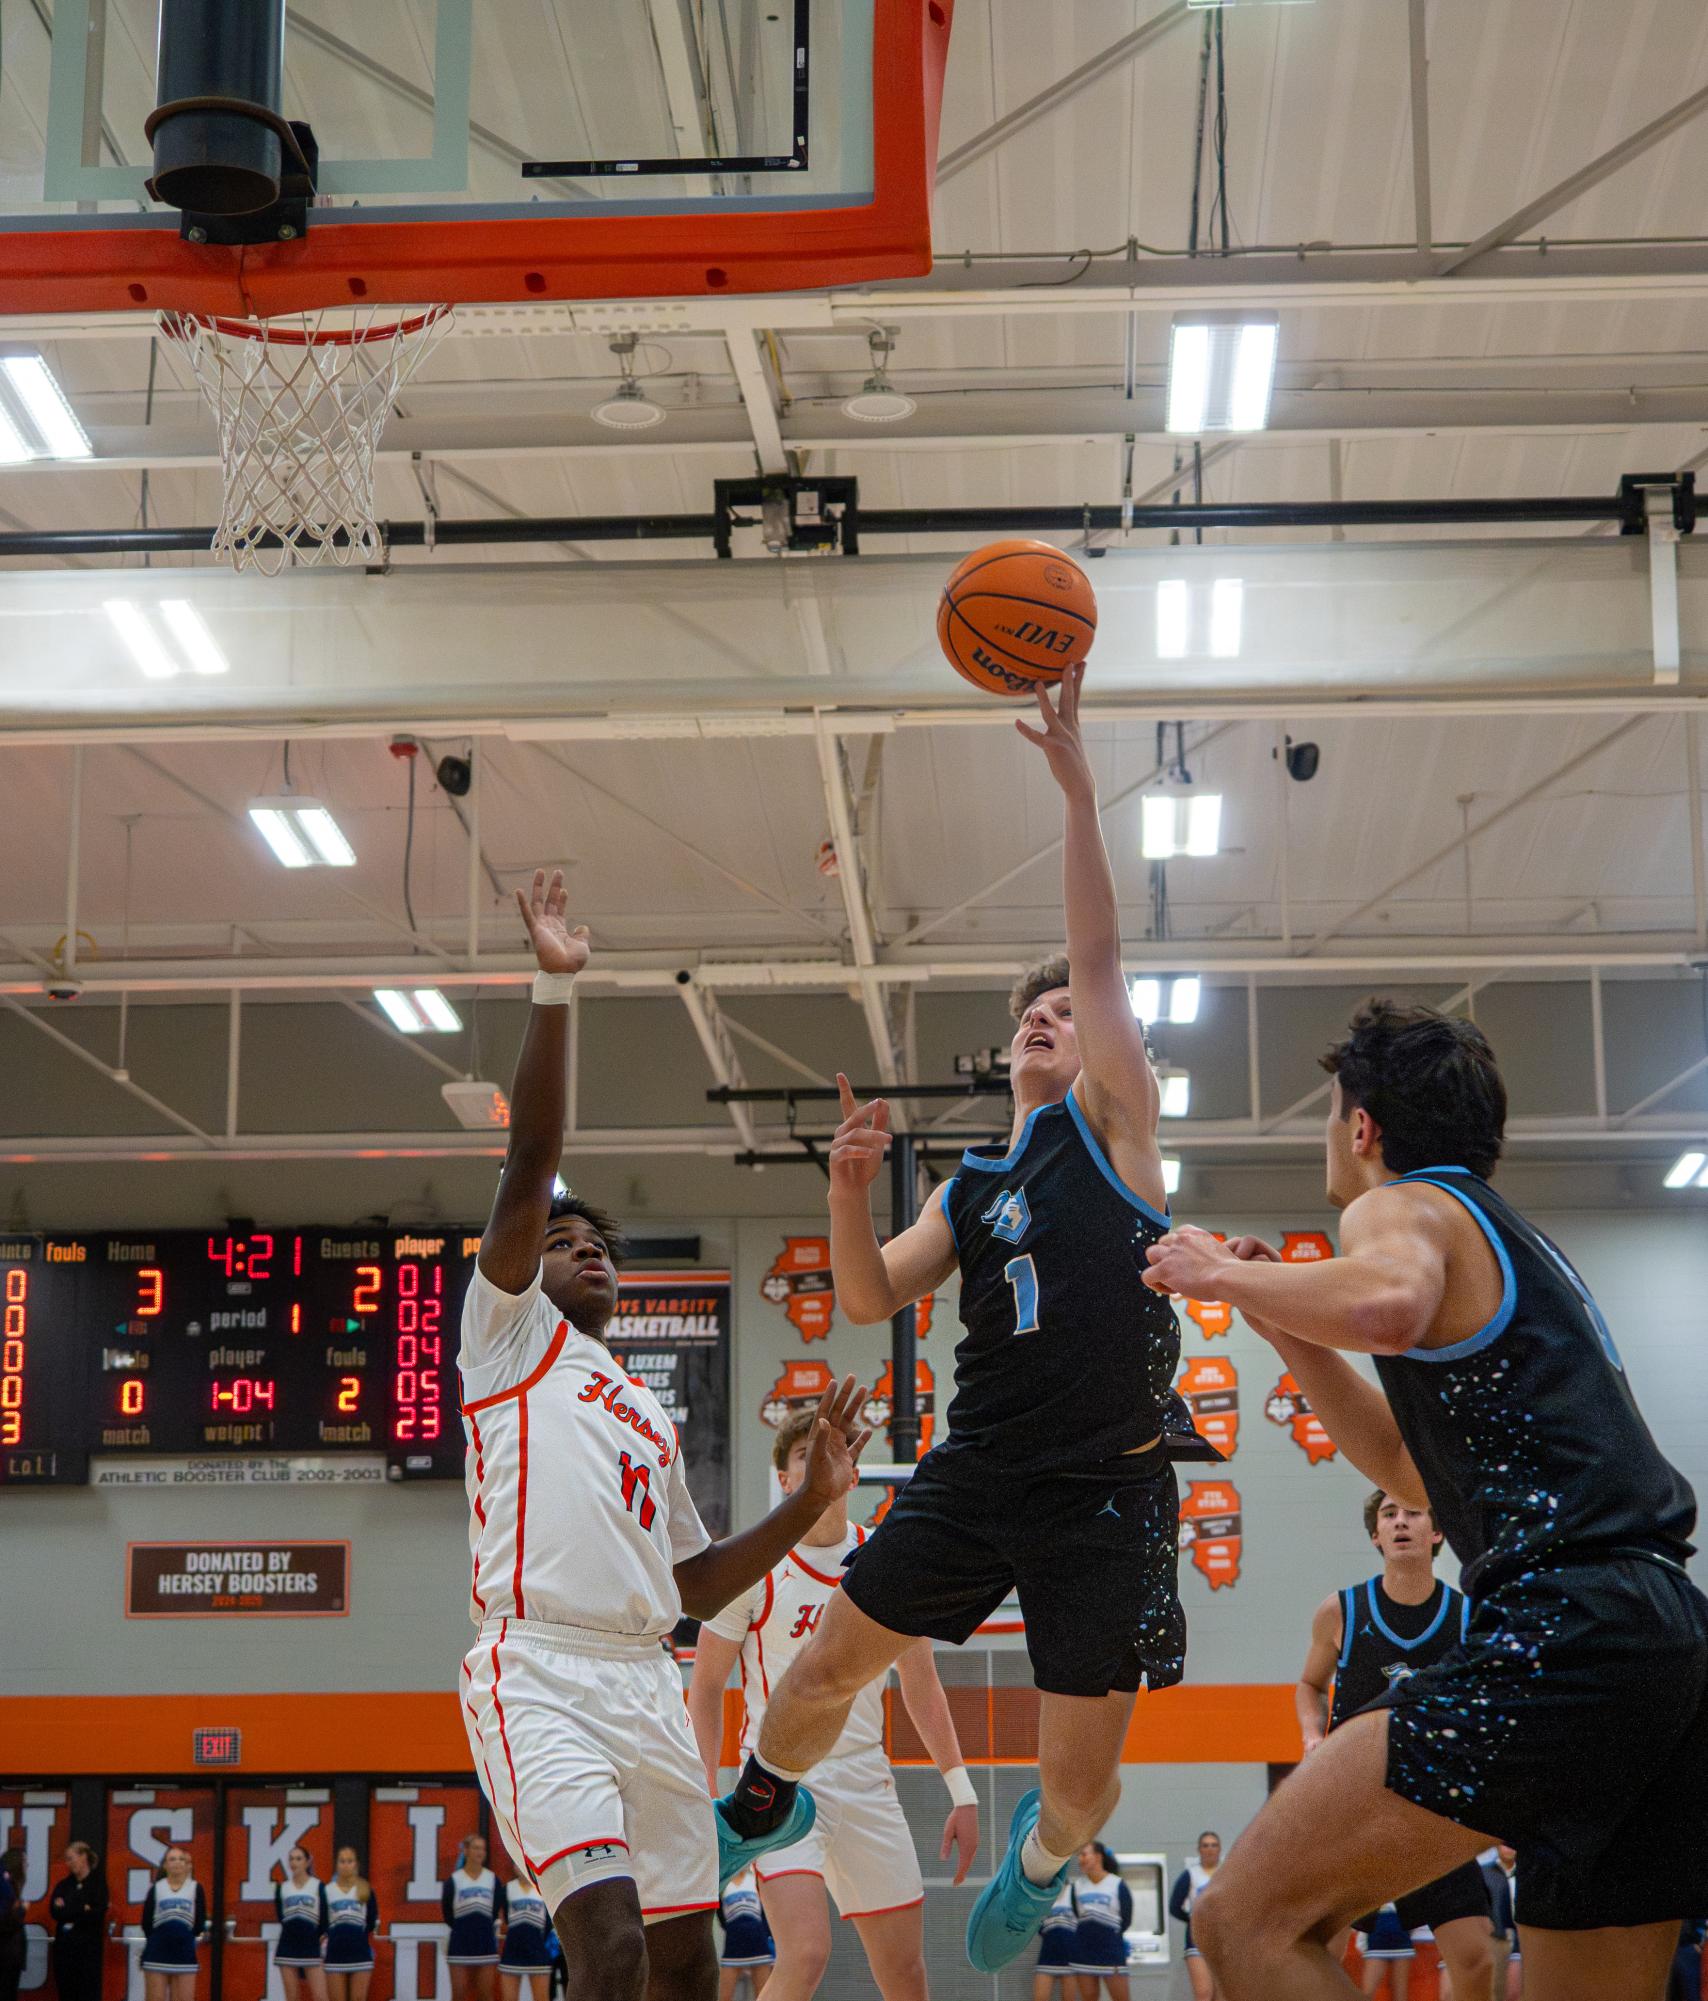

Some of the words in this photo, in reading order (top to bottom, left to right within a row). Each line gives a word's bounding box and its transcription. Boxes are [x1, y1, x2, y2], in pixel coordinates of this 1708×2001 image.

[1014, 620, 1076, 654] EVO
[46, 1241, 87, 1263] fouls
[107, 1241, 156, 1261] Home
[320, 1237, 381, 1259] Guests
[394, 1235, 446, 1259] player
[6, 1269, 27, 1302] 0
[137, 1269, 162, 1315] 3
[354, 1266, 382, 1312] 2
[1004, 1253, 1040, 1335] 1
[292, 1303, 300, 1334] 1
[398, 1299, 441, 1332] 02
[645, 1299, 718, 1314] VARSITY
[5, 1304, 26, 1337] 0
[209, 1307, 267, 1331] period
[604, 1315, 720, 1339] ASKETBALL
[3, 1340, 24, 1373] 0
[209, 1346, 266, 1370] player
[326, 1347, 367, 1367] fouls
[397, 1335, 441, 1367] 04
[122, 1380, 144, 1414] 0
[338, 1377, 360, 1411] 2
[396, 1370, 440, 1403] 05
[1, 1411, 21, 1445] 3
[205, 1421, 263, 1444] weight
[323, 1422, 371, 1442] match
[396, 1405, 441, 1439] 23
[103, 1425, 151, 1446] match
[99, 1471, 167, 1483] ATHLETIC
[173, 1470, 245, 1482] BOOSTER
[251, 1470, 290, 1481] CLUB
[185, 1552, 264, 1572] DONATED
[268, 1551, 292, 1572] BY
[158, 1574, 224, 1594] HERSEY
[228, 1573, 318, 1594] BOOSTERS
[202, 1736, 232, 1760] EXIT
